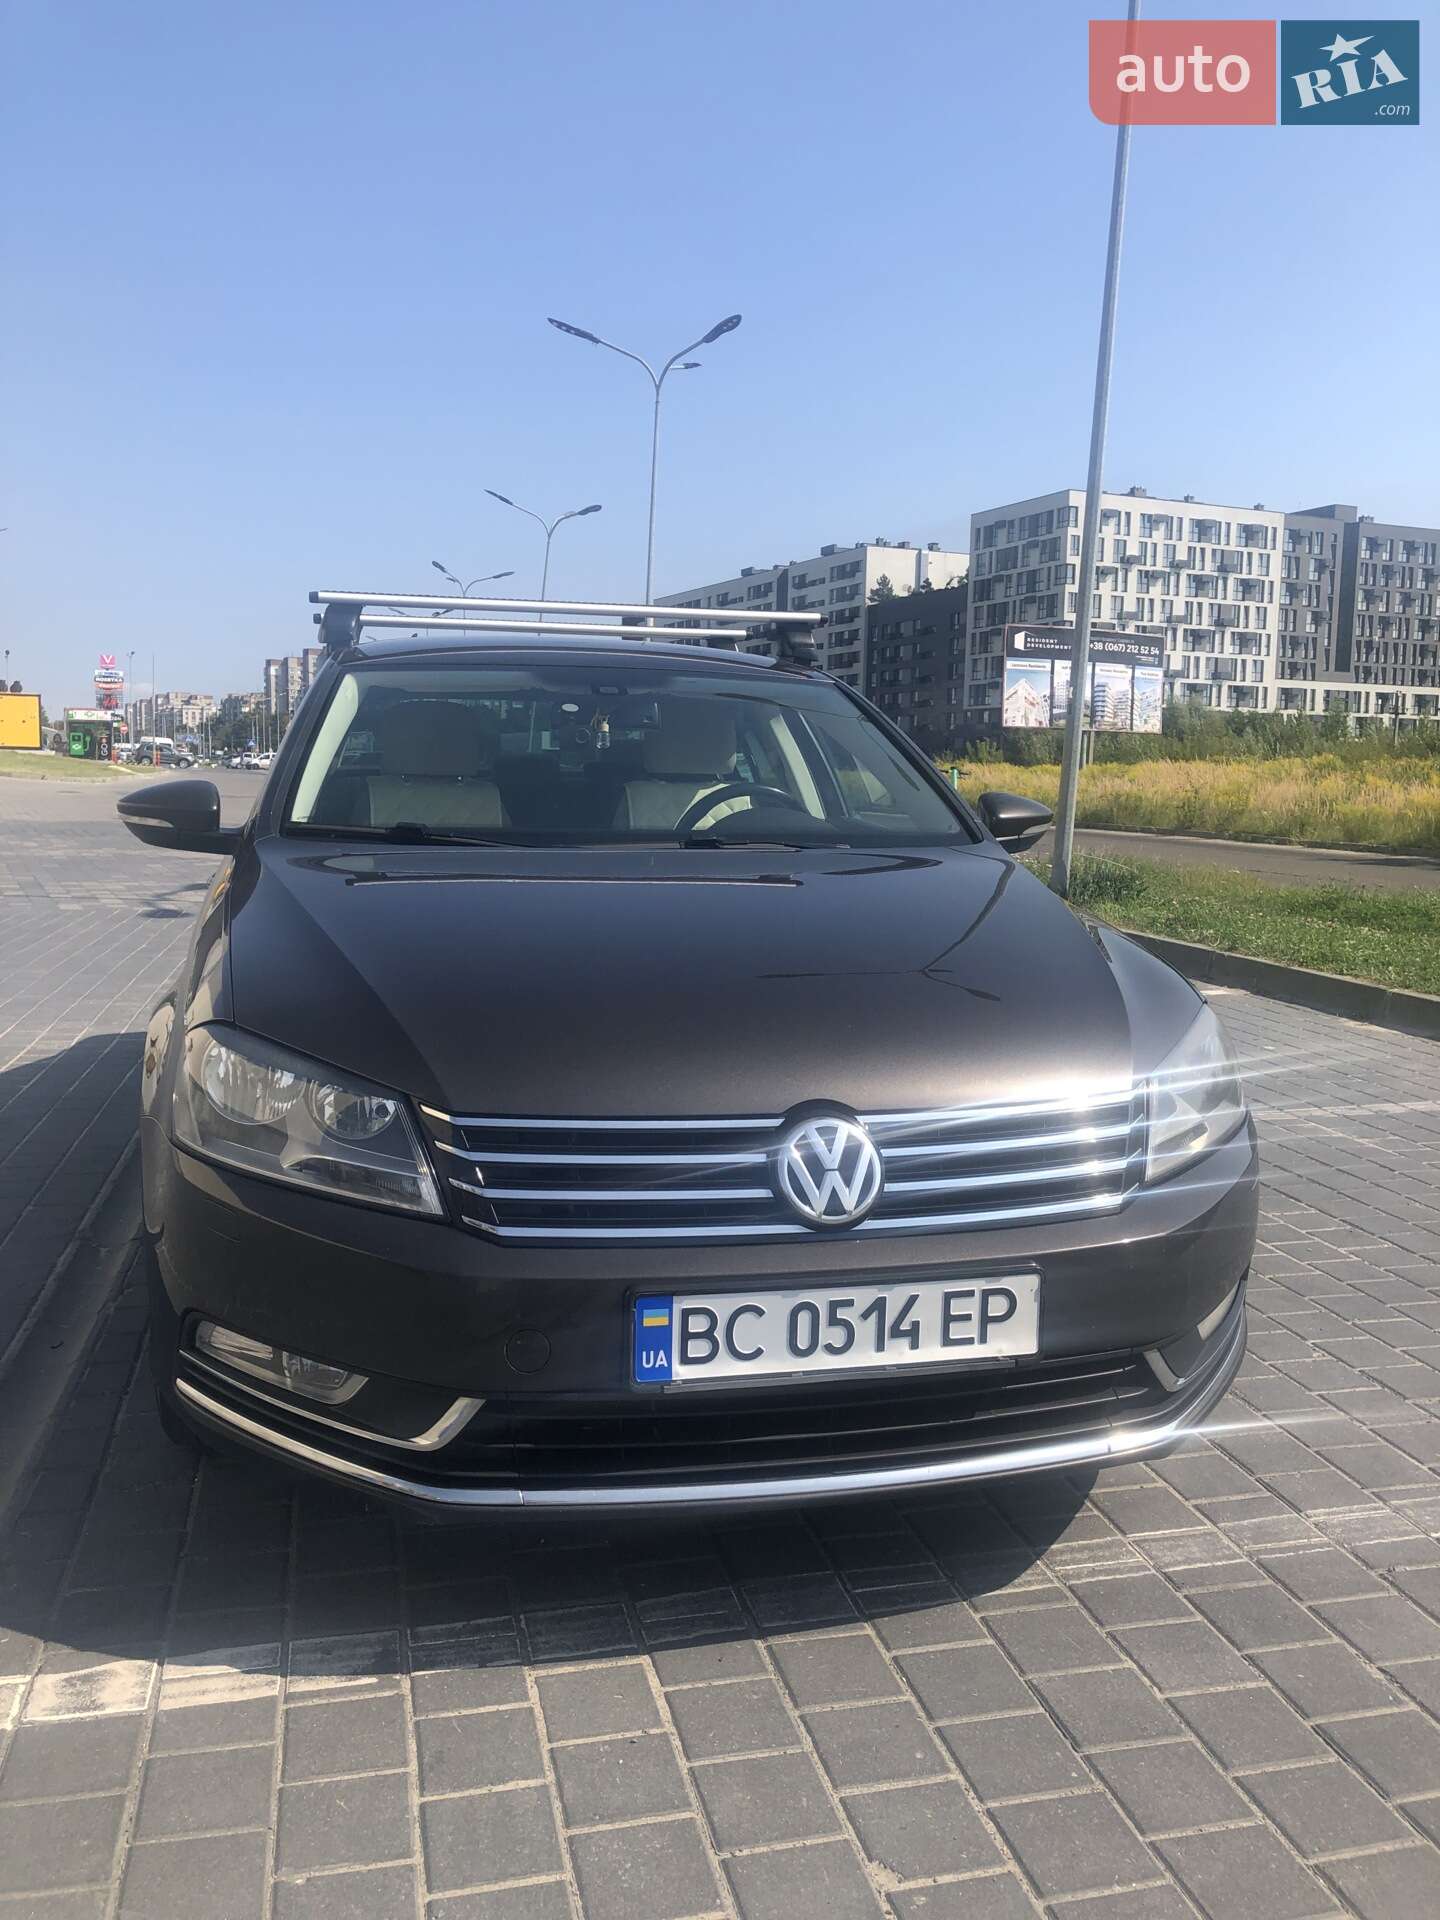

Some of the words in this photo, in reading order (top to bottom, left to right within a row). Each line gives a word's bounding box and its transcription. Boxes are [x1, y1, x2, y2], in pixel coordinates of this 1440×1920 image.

[1089, 641, 1104, 650] +38
[1104, 642, 1126, 653] (067)
[1126, 644, 1139, 654] 212
[1140, 646, 1149, 655] 52
[1150, 646, 1160, 656] 54
[679, 1303, 767, 1366] BC
[788, 1293, 921, 1358] 0514
[941, 1287, 1019, 1347] EP
[642, 1349, 669, 1369] UA
